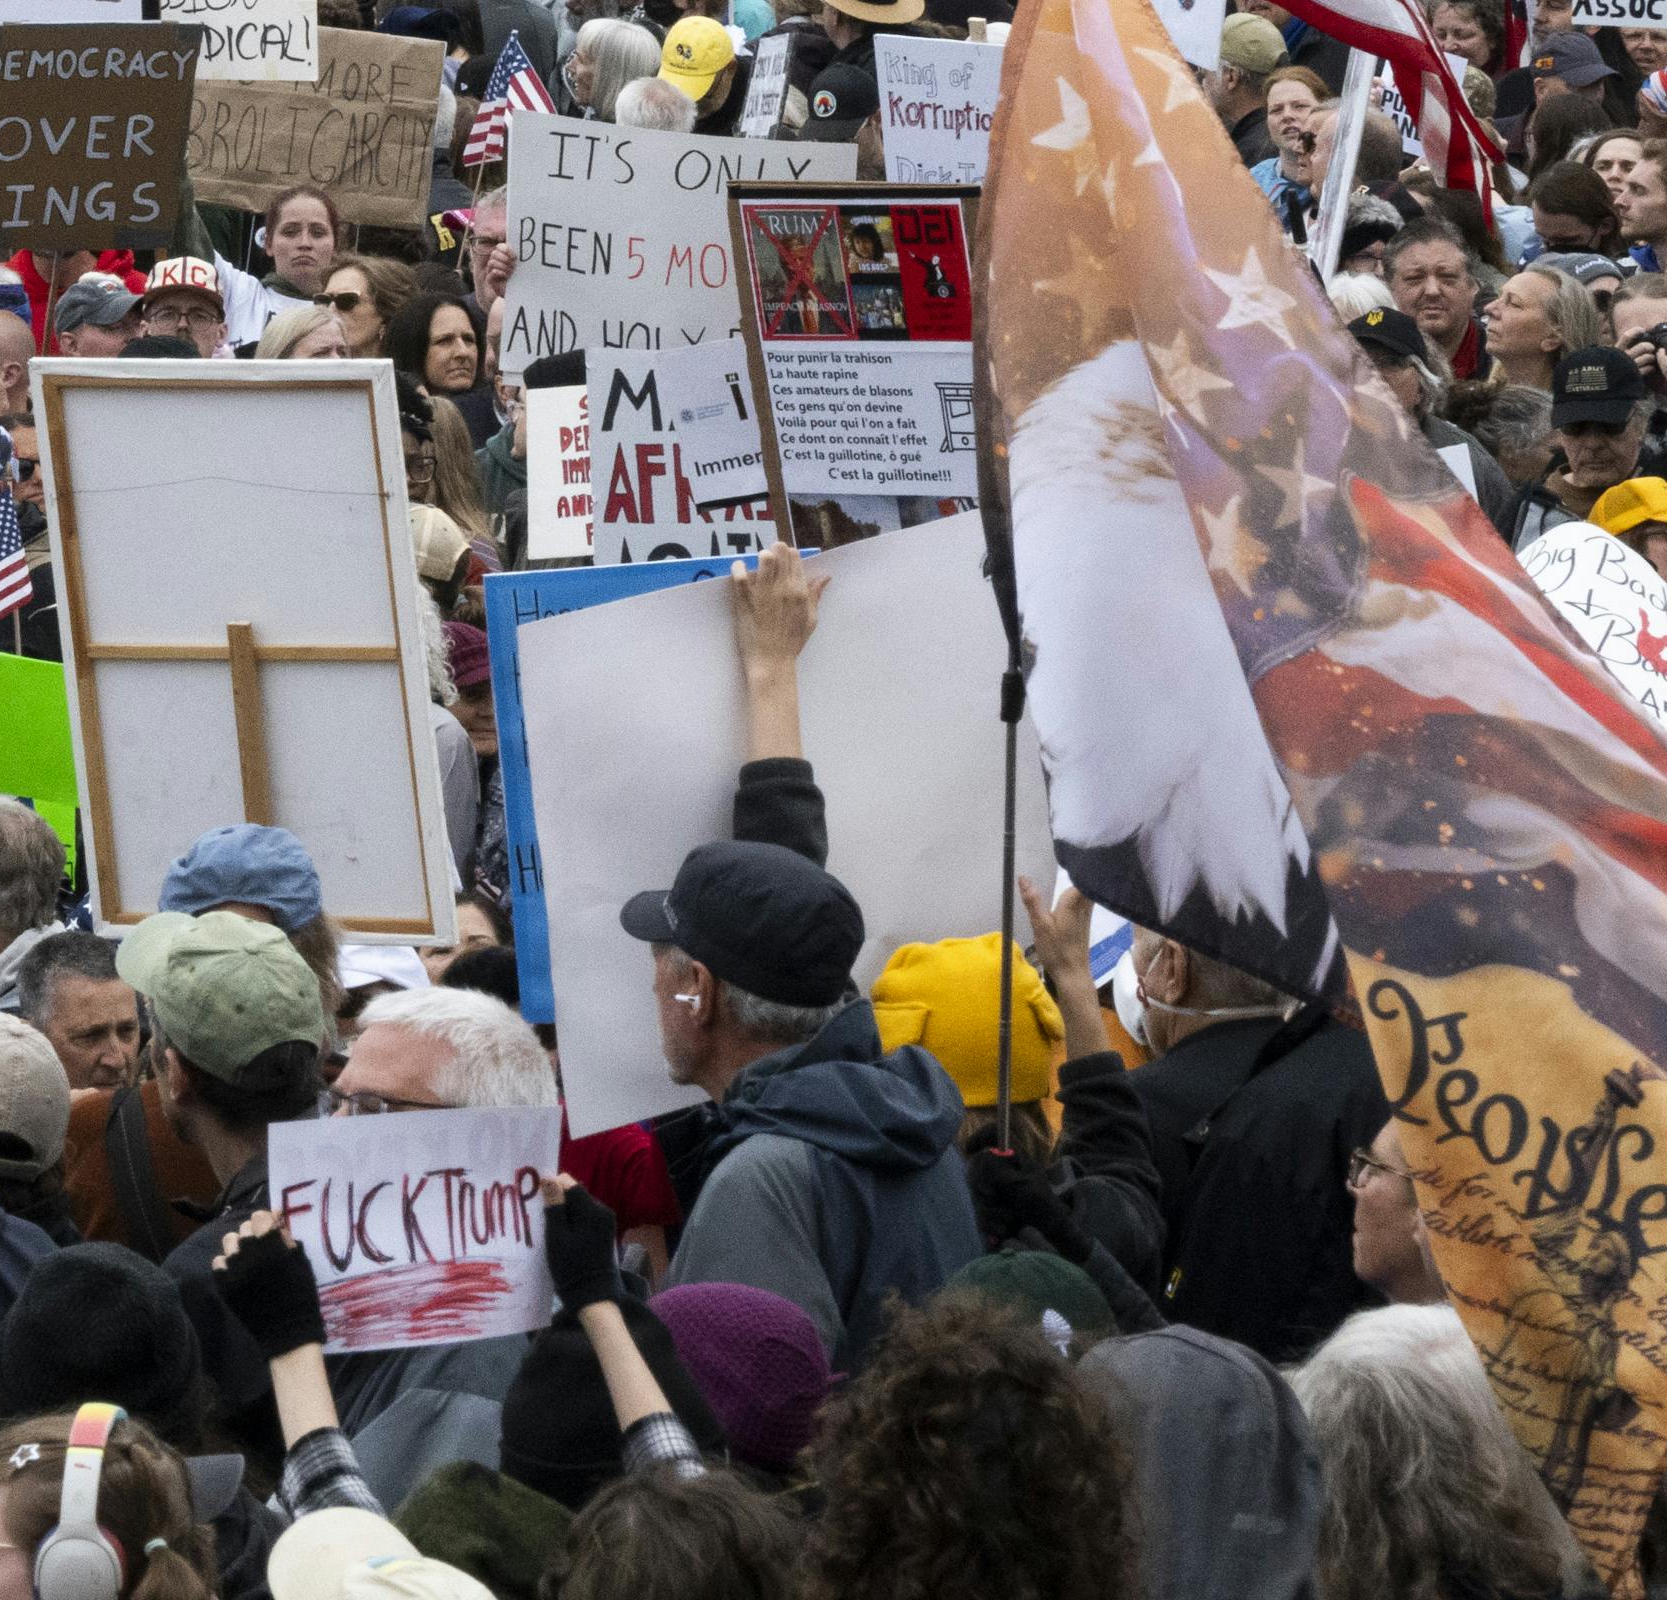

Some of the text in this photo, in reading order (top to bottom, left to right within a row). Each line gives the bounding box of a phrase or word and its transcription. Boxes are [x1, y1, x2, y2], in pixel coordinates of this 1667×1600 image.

[768, 353, 892, 366] Pour punir la trahison
[773, 385, 913, 396] Ces amateurs de blasons
[829, 468, 951, 483] C'est la guillotine!!!
[279, 1172, 436, 1273] FUCK
